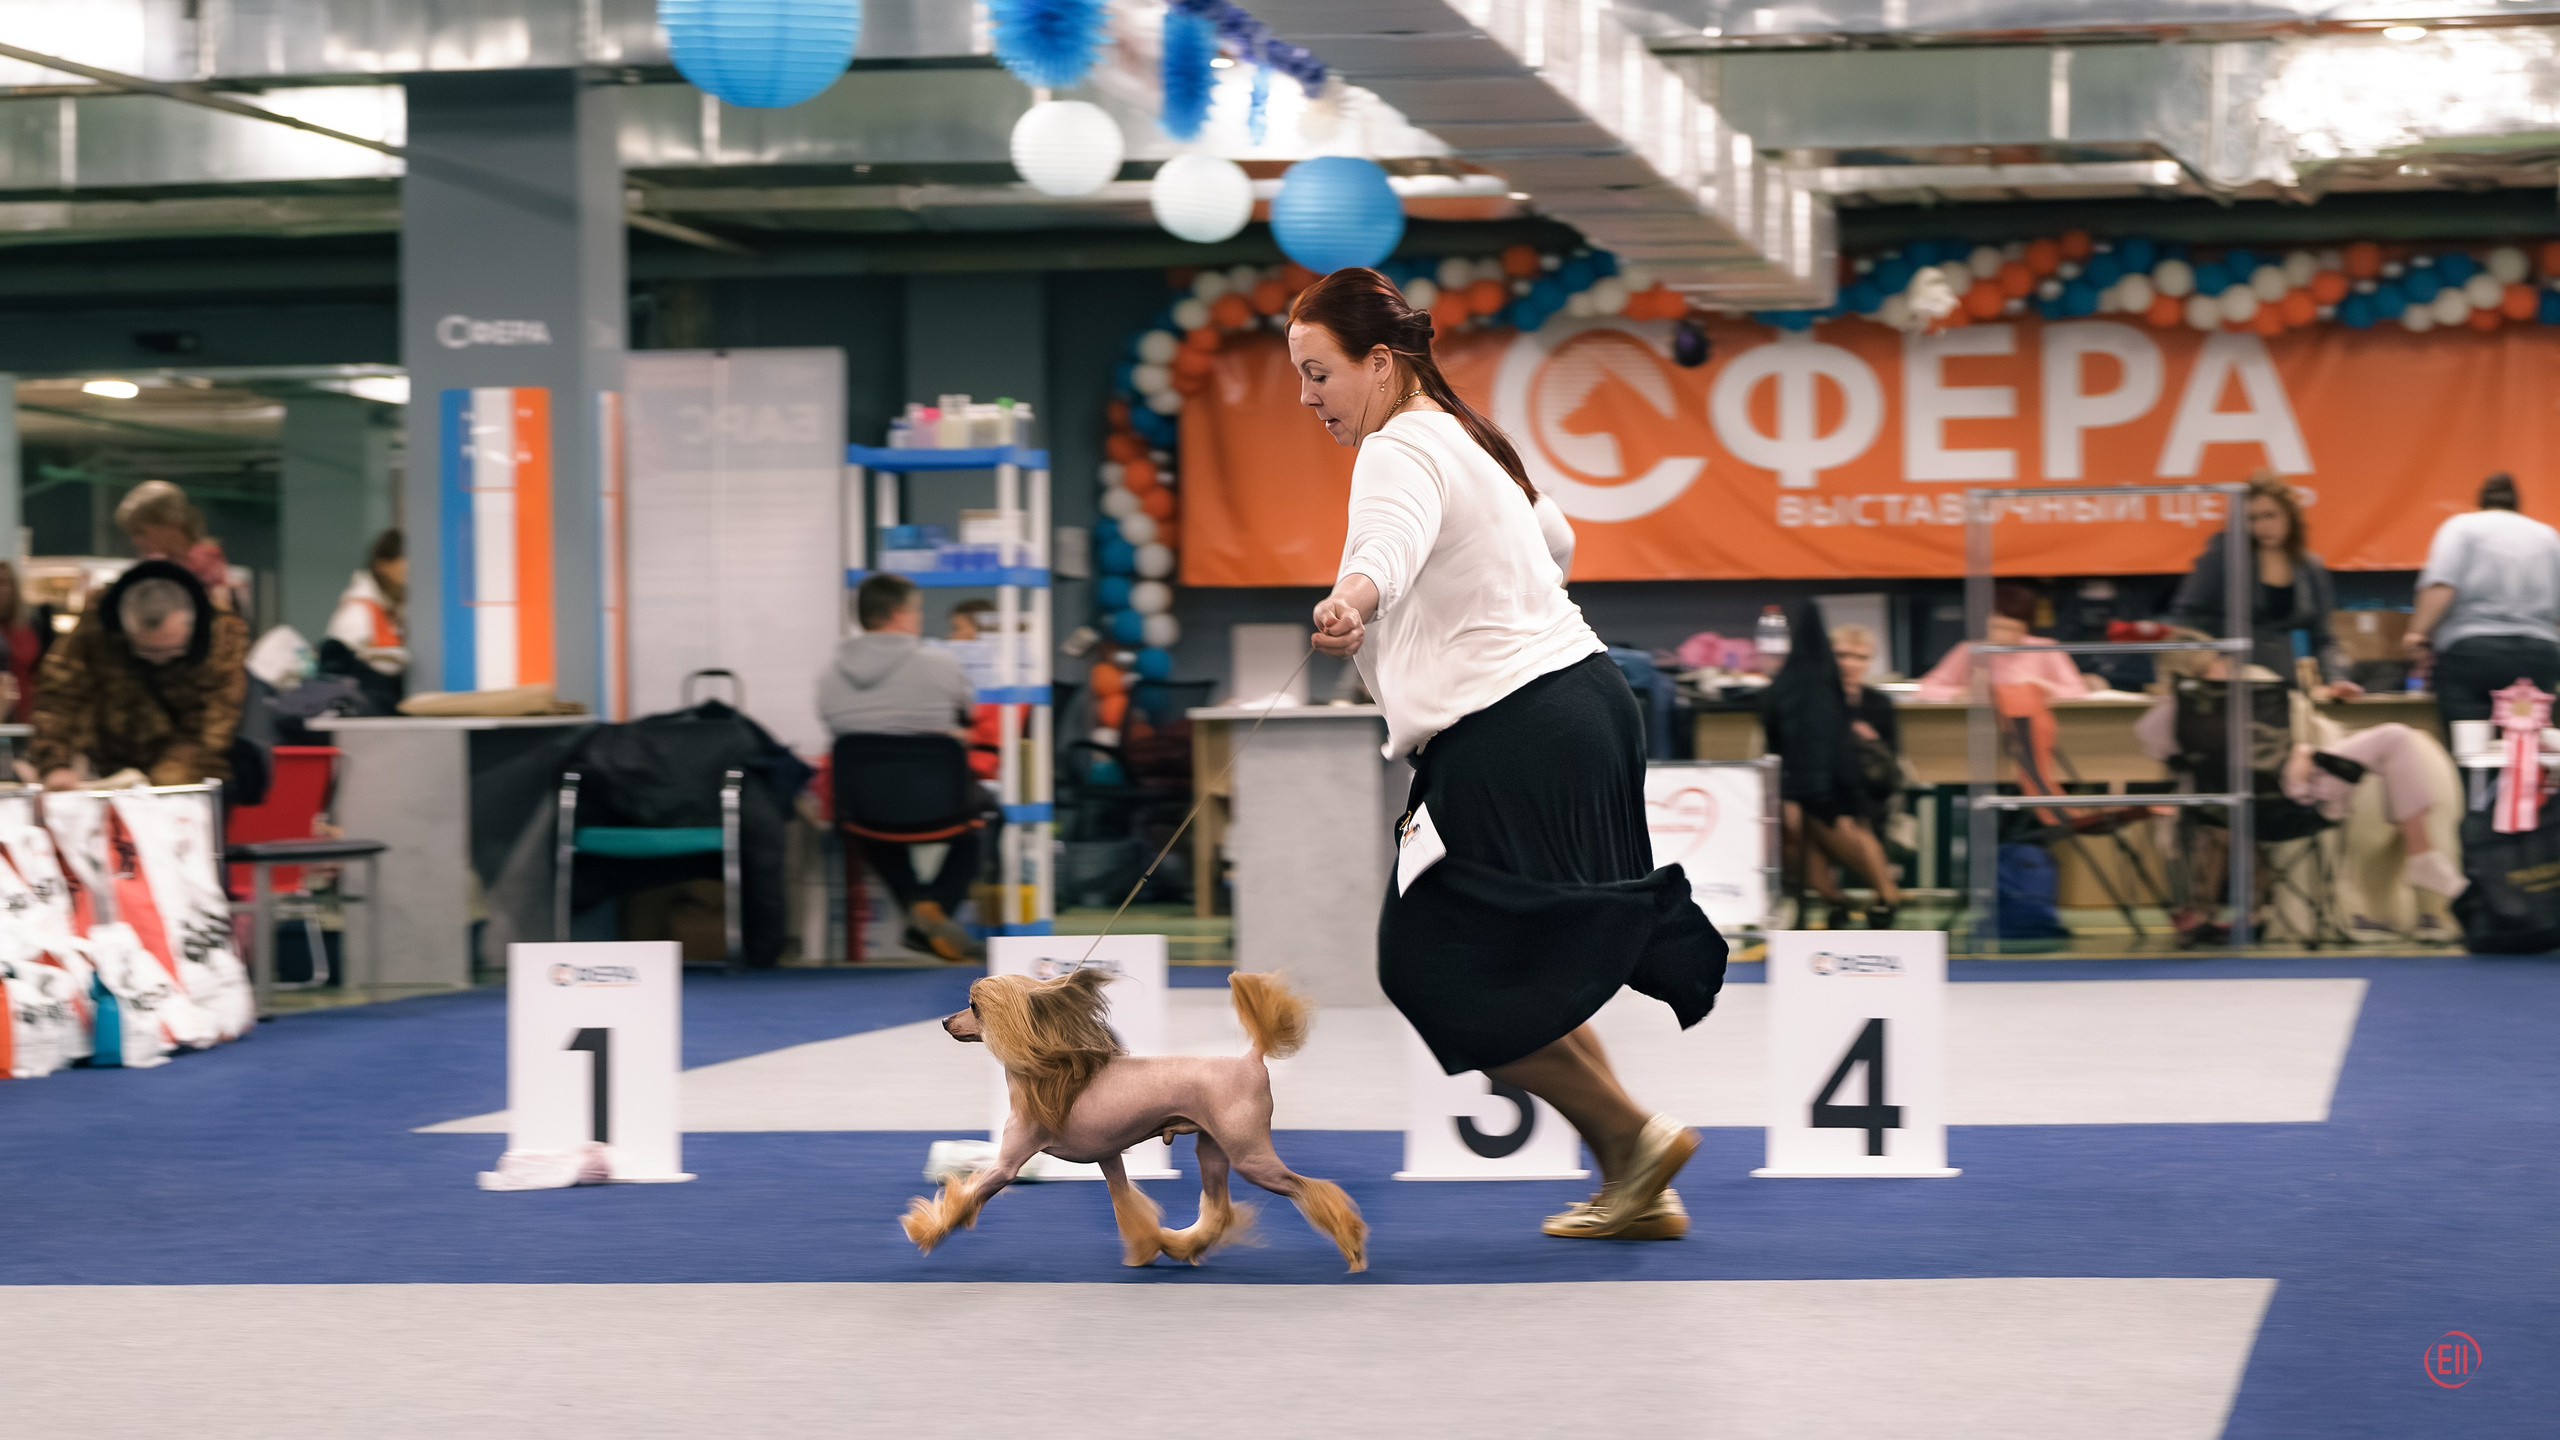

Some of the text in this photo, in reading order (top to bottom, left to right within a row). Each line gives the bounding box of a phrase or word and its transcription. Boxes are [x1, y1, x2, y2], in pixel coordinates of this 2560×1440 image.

[1493, 319, 2317, 522] СФЕРА
[561, 1028, 614, 1142] 1
[1807, 1018, 1908, 1156] 4
